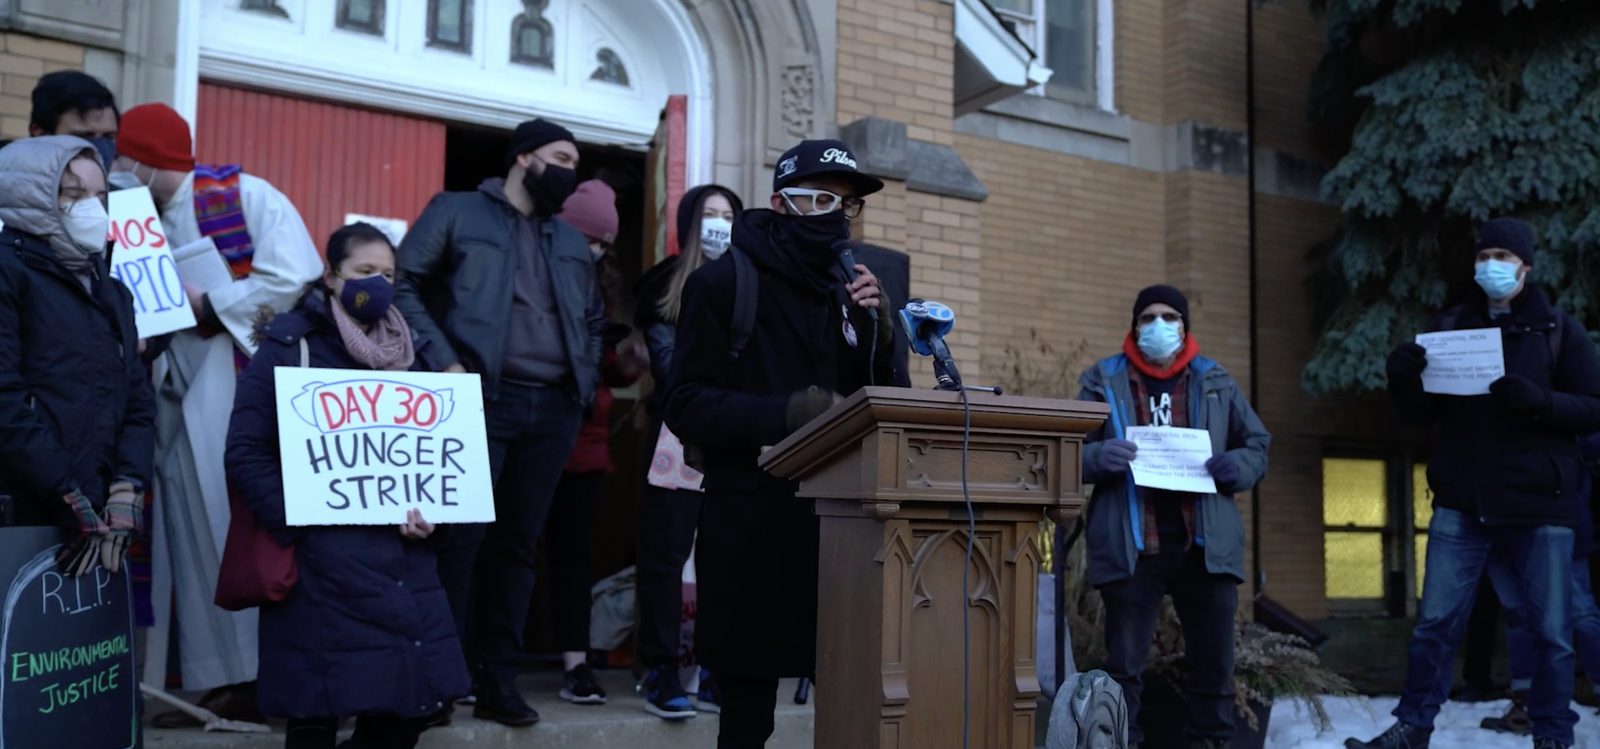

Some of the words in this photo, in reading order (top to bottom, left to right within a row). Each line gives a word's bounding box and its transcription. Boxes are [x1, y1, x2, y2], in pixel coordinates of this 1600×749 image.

[319, 383, 384, 429] DAY
[394, 386, 437, 427] 30
[306, 432, 466, 474] HUNGER
[326, 473, 459, 510] STRIKE
[11, 634, 129, 682] ENVIRONMENTAL
[39, 664, 120, 713] JUSTICE
